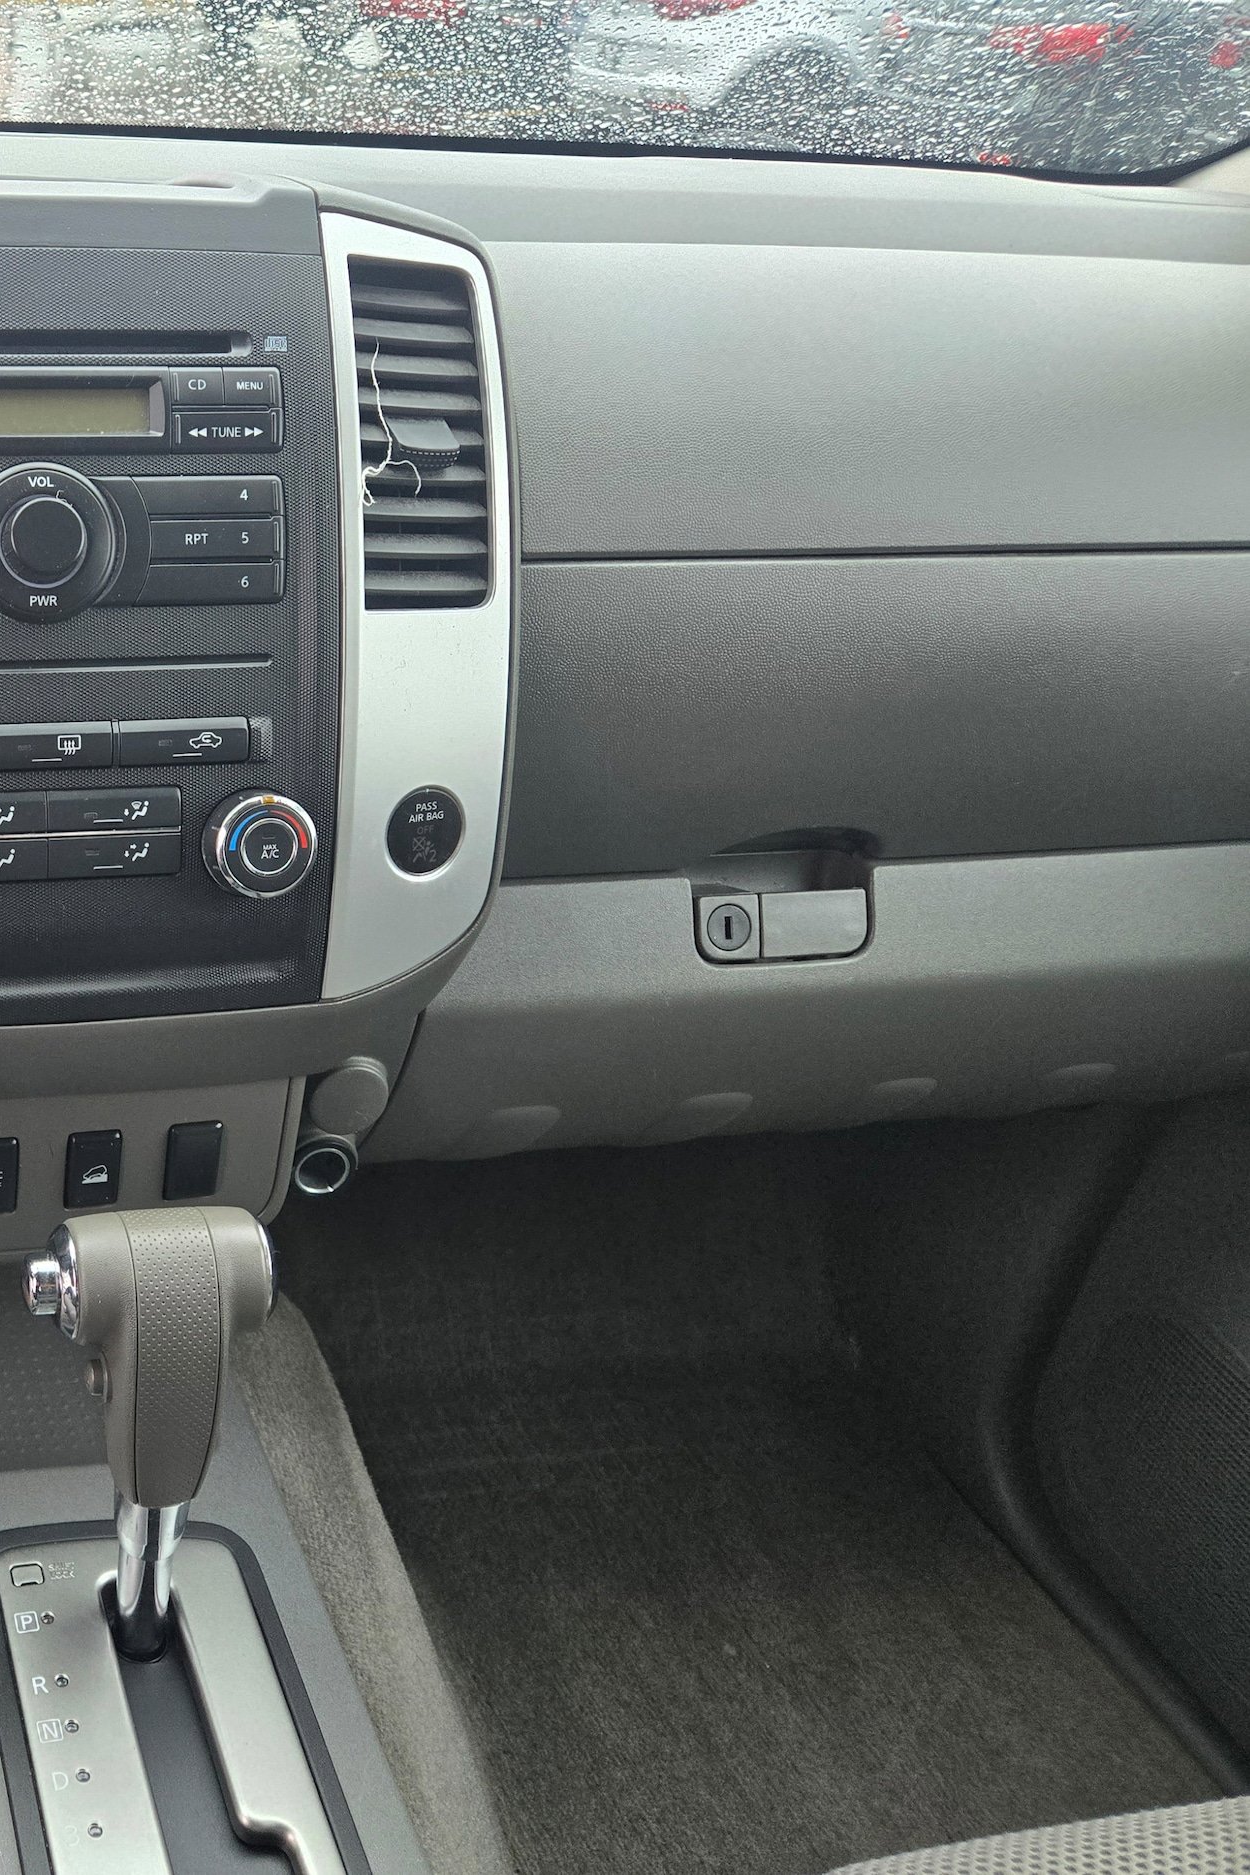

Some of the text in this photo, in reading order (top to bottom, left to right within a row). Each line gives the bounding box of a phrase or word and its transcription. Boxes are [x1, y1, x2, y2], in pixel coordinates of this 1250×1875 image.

[188, 379, 207, 390] CD
[236, 381, 264, 390] MENU
[211, 427, 242, 438] TUNE
[28, 476, 54, 488] VOL
[239, 489, 249, 501] 4
[185, 532, 249, 545] RPT 5
[240, 576, 249, 588] 6
[29, 595, 58, 607] PWR
[415, 801, 438, 812] PASS
[408, 810, 444, 823] AIR BAG
[416, 825, 435, 835] OFF
[260, 850, 280, 859] A/C
[20, 1615, 33, 1631] P
[31, 1676, 50, 1695] R
[41, 1721, 59, 1740] N
[52, 1771, 69, 1791] D
